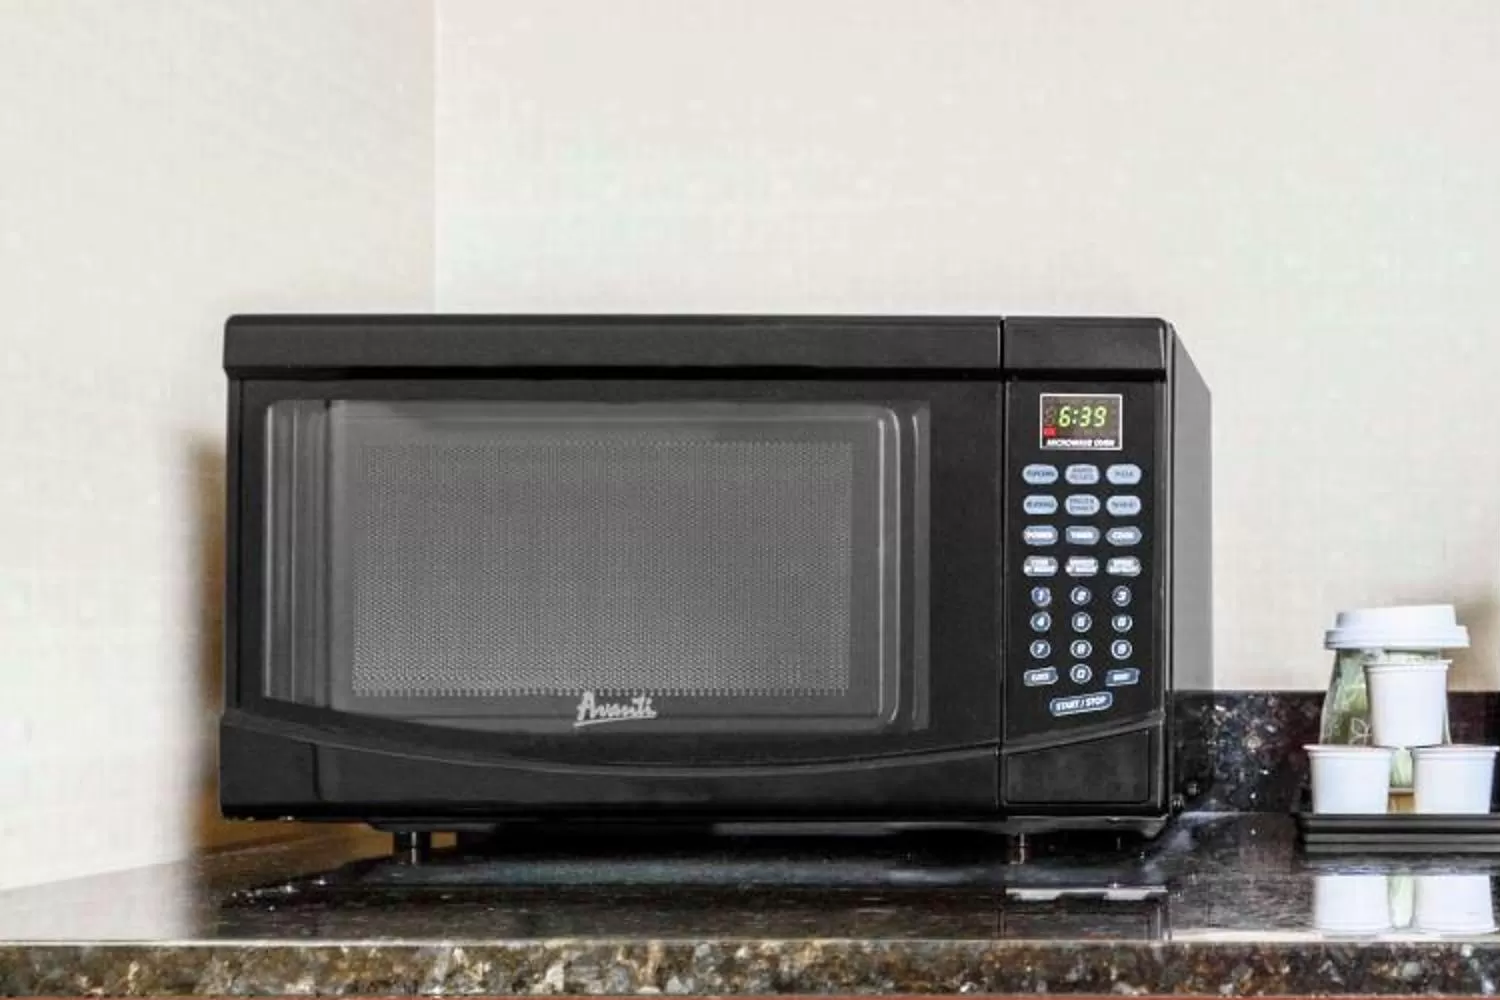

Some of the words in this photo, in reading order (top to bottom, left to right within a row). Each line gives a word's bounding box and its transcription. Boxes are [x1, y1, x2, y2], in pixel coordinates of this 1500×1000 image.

[1058, 405, 1108, 427] 6:39
[1046, 439, 1092, 447] MICROWAVE
[1093, 439, 1116, 447] OVEN
[1076, 669, 1086, 679] 0
[574, 691, 657, 724] Avanti
[1055, 700, 1080, 711] START
[1085, 695, 1107, 707] STOP
